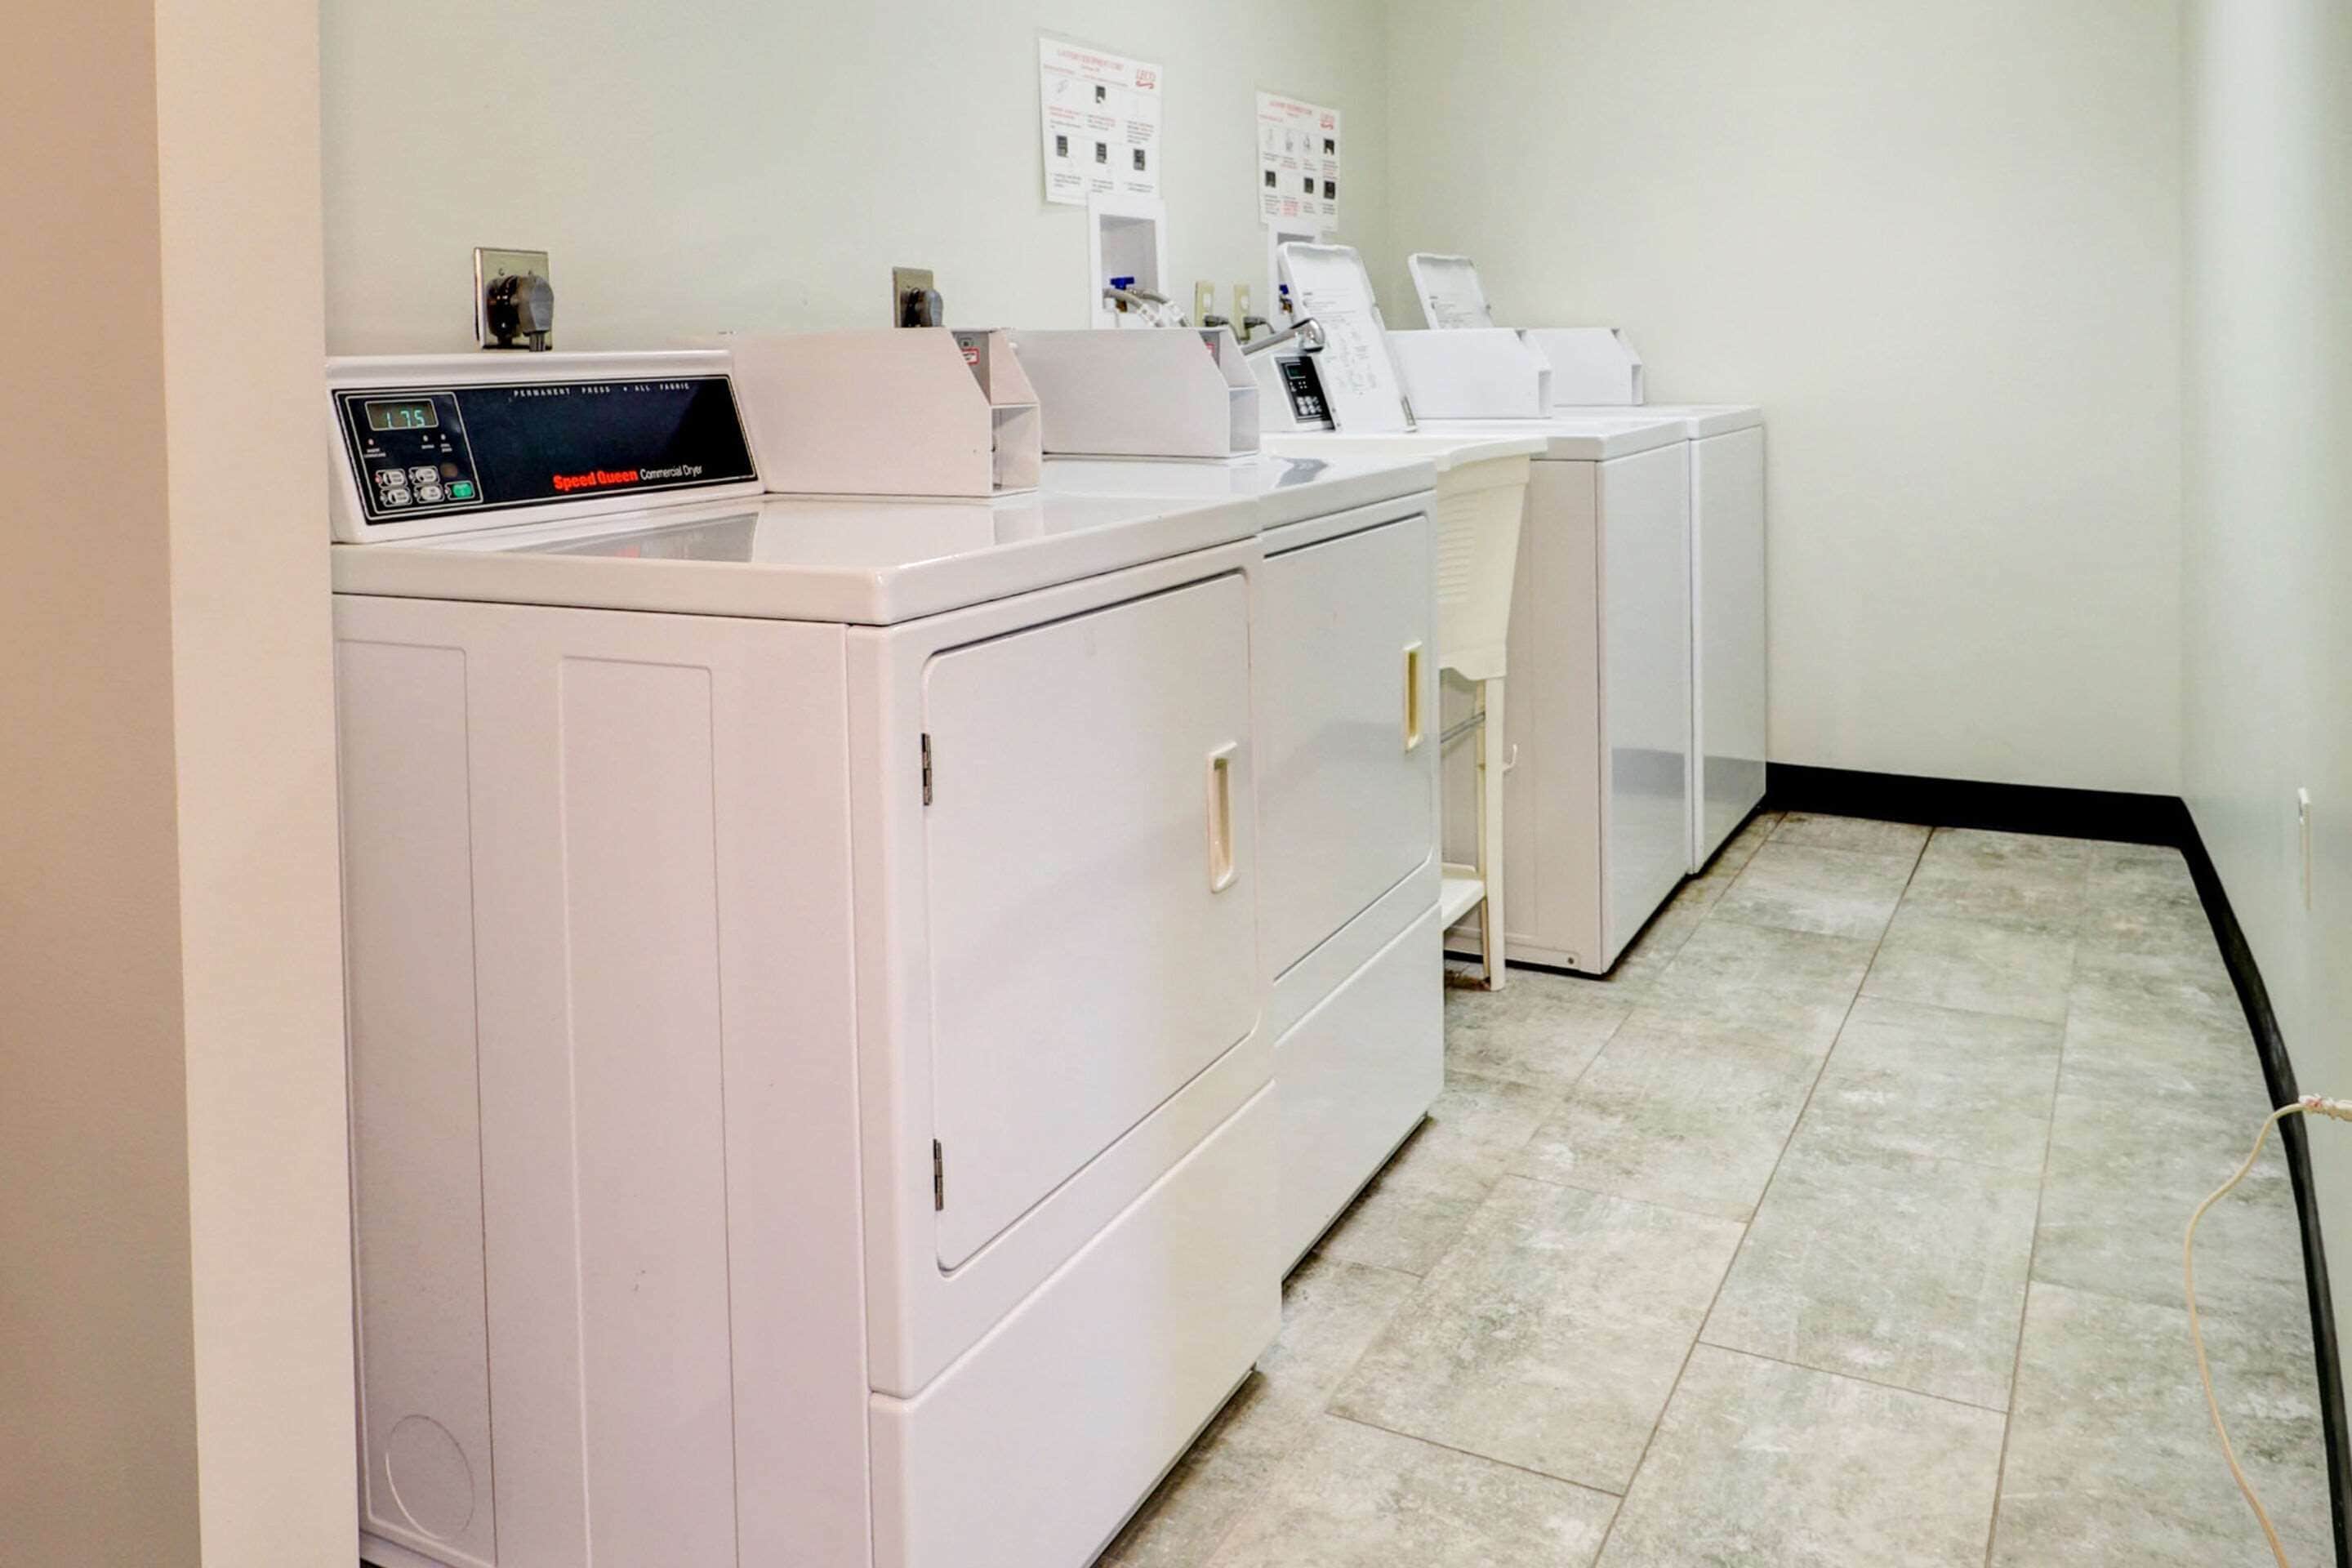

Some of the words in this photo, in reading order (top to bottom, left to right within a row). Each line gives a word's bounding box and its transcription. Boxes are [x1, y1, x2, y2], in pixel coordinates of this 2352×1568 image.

[514, 388, 571, 397] PERMANENT
[659, 382, 690, 390] FABRIC
[553, 471, 596, 492] Speed
[597, 470, 638, 485] Queen
[640, 466, 682, 480] Commercial
[683, 464, 702, 479] Dryer
